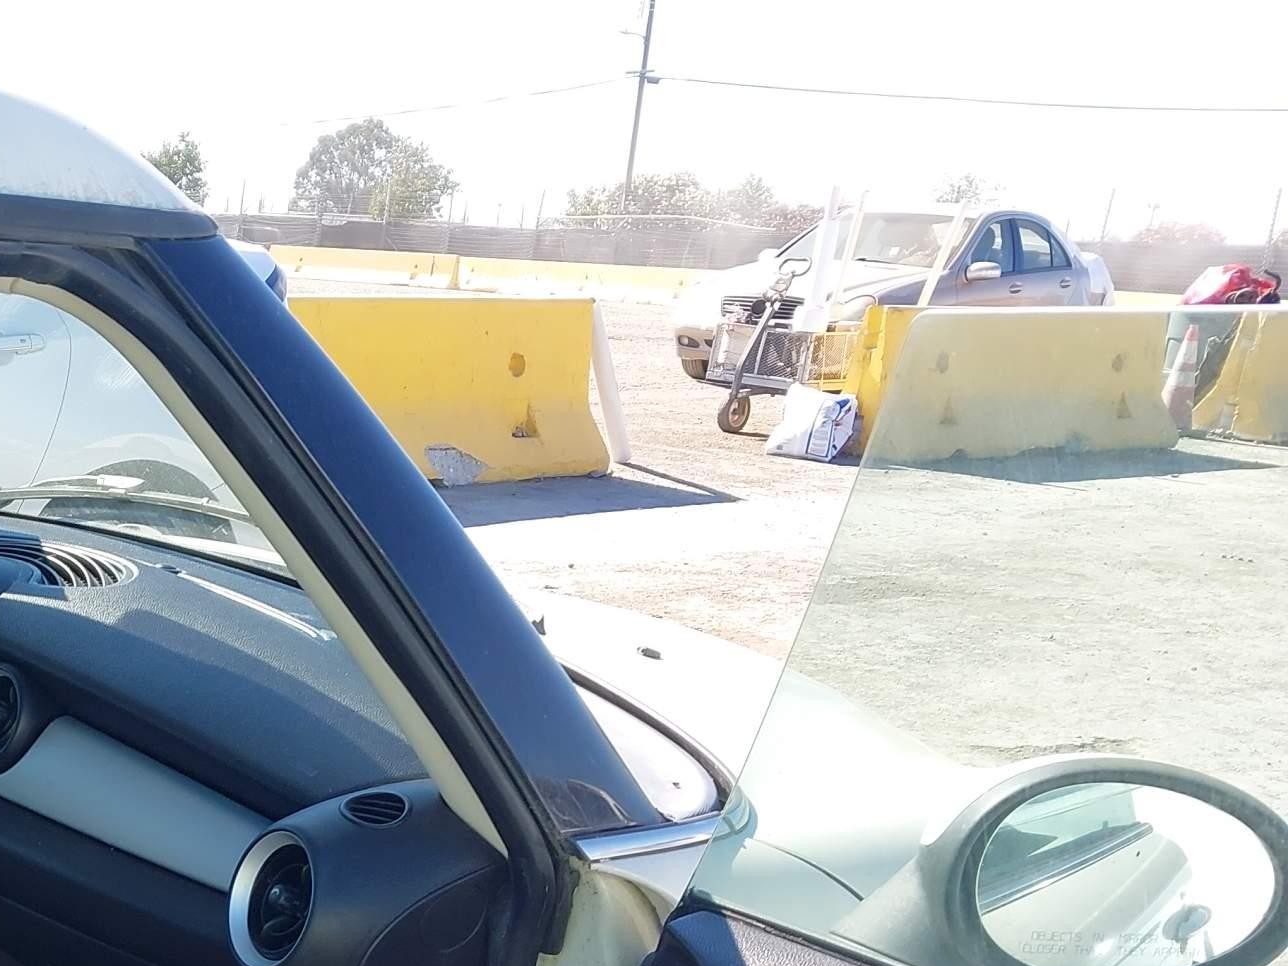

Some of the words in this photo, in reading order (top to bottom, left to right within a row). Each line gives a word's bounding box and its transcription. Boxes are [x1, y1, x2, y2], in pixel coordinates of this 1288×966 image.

[1030, 930, 1082, 943] OBJECTS
[1093, 931, 1106, 943] IN
[1021, 943, 1065, 955] CLOSER
